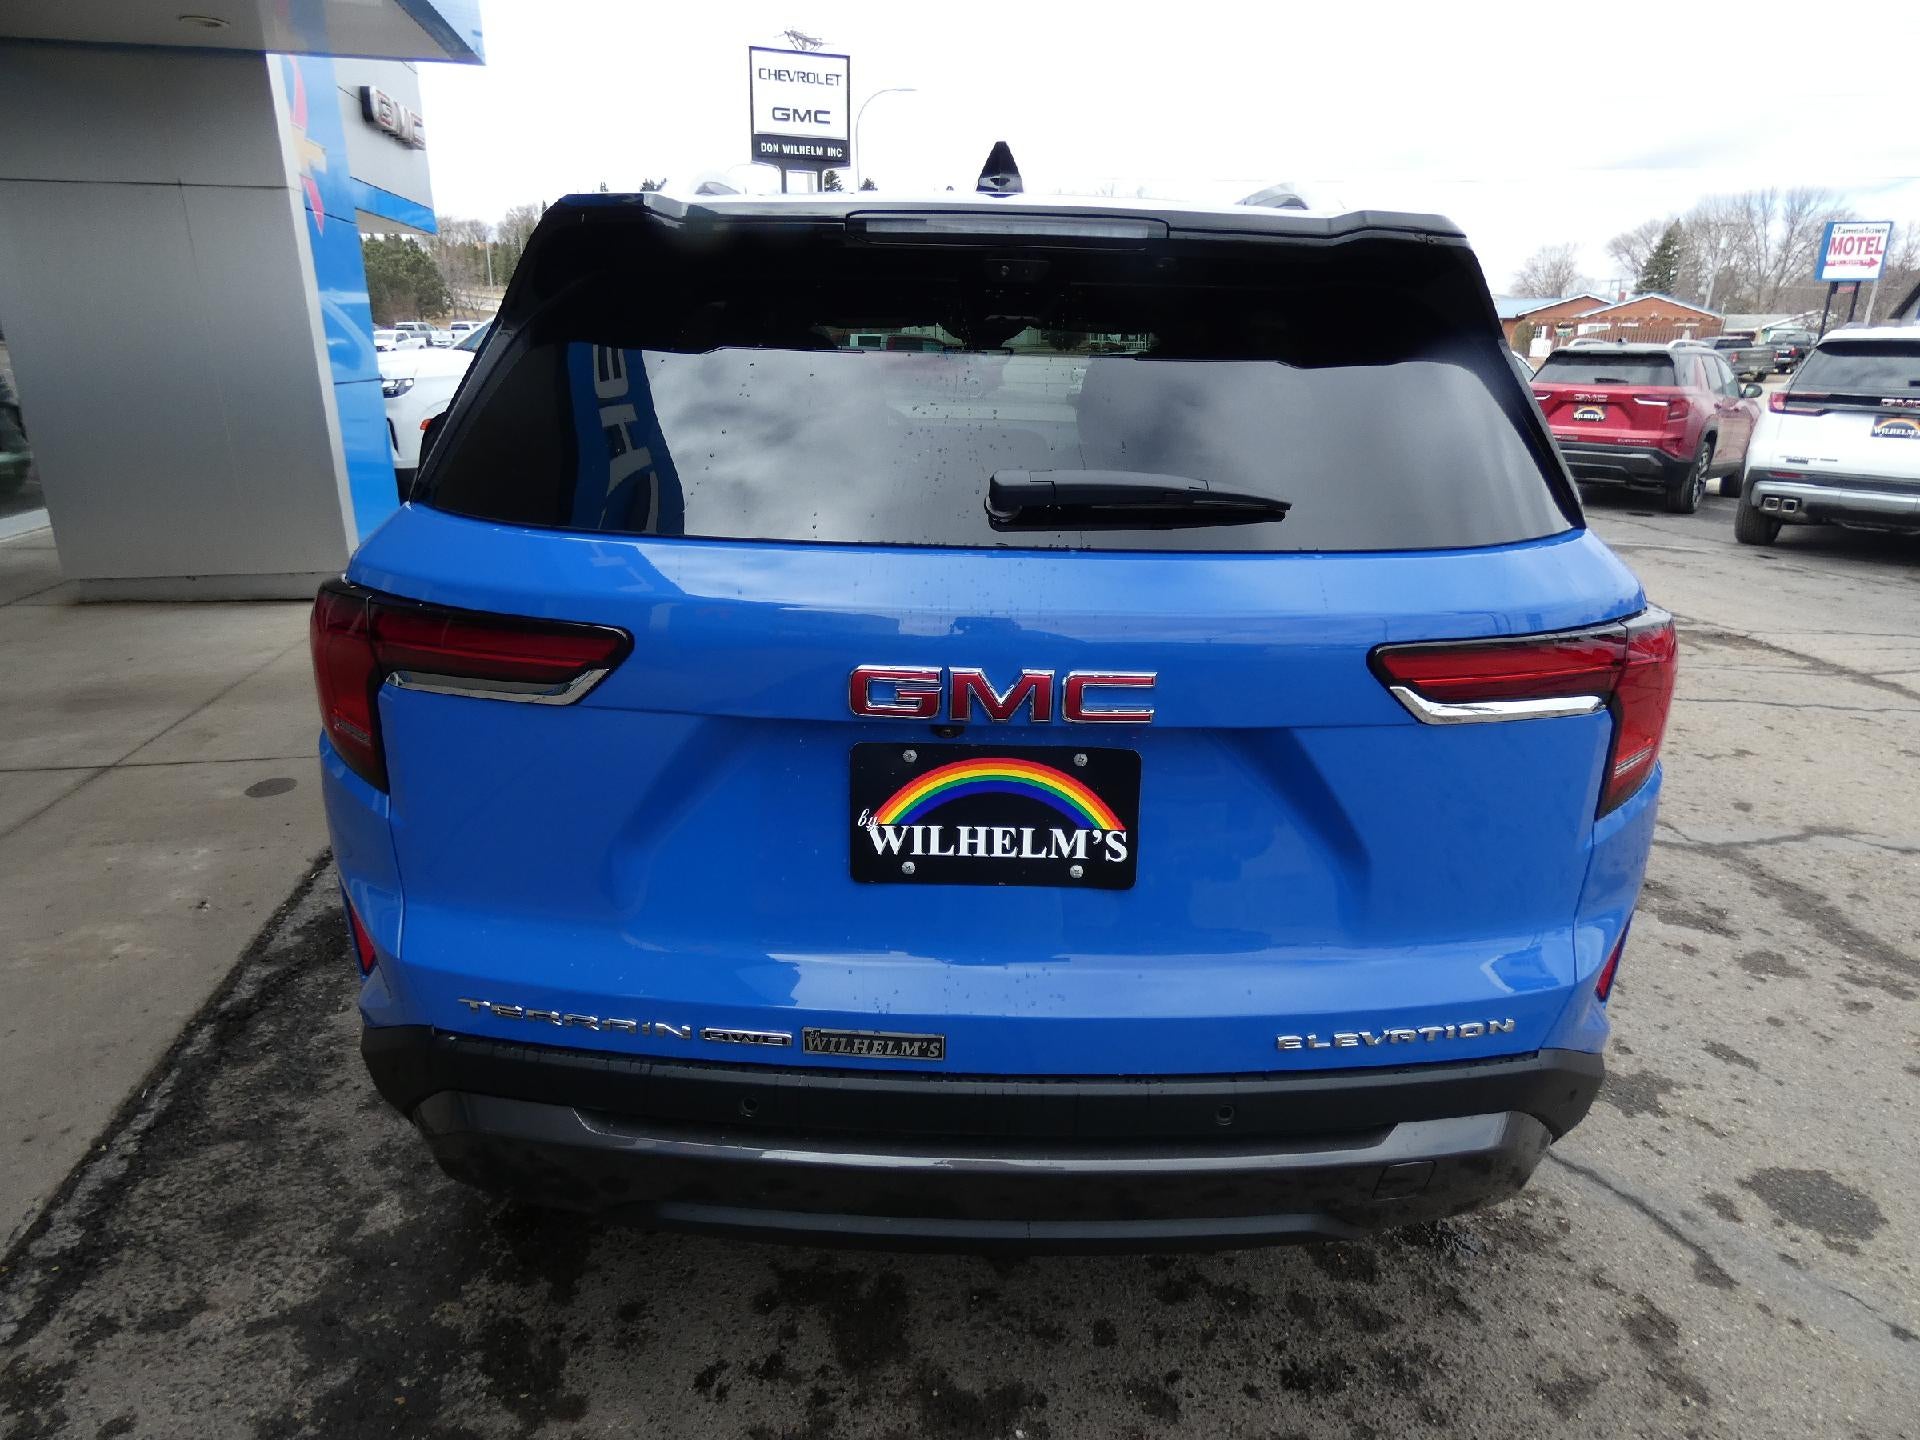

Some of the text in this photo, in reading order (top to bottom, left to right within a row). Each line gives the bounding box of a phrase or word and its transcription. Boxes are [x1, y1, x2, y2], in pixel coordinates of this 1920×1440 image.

[759, 67, 842, 86] CHEVROLET
[772, 106, 831, 124] GMC
[760, 142, 843, 157] DON WILHELM INC
[1829, 236, 1884, 255] MOTEL
[849, 664, 1157, 723] GMC
[858, 808, 879, 831] by
[870, 825, 1128, 863] WILHELM'S
[457, 998, 690, 1041] TERRAIN
[1276, 1018, 1516, 1049] ELEVATION
[806, 1035, 941, 1058] WILHELM'S
